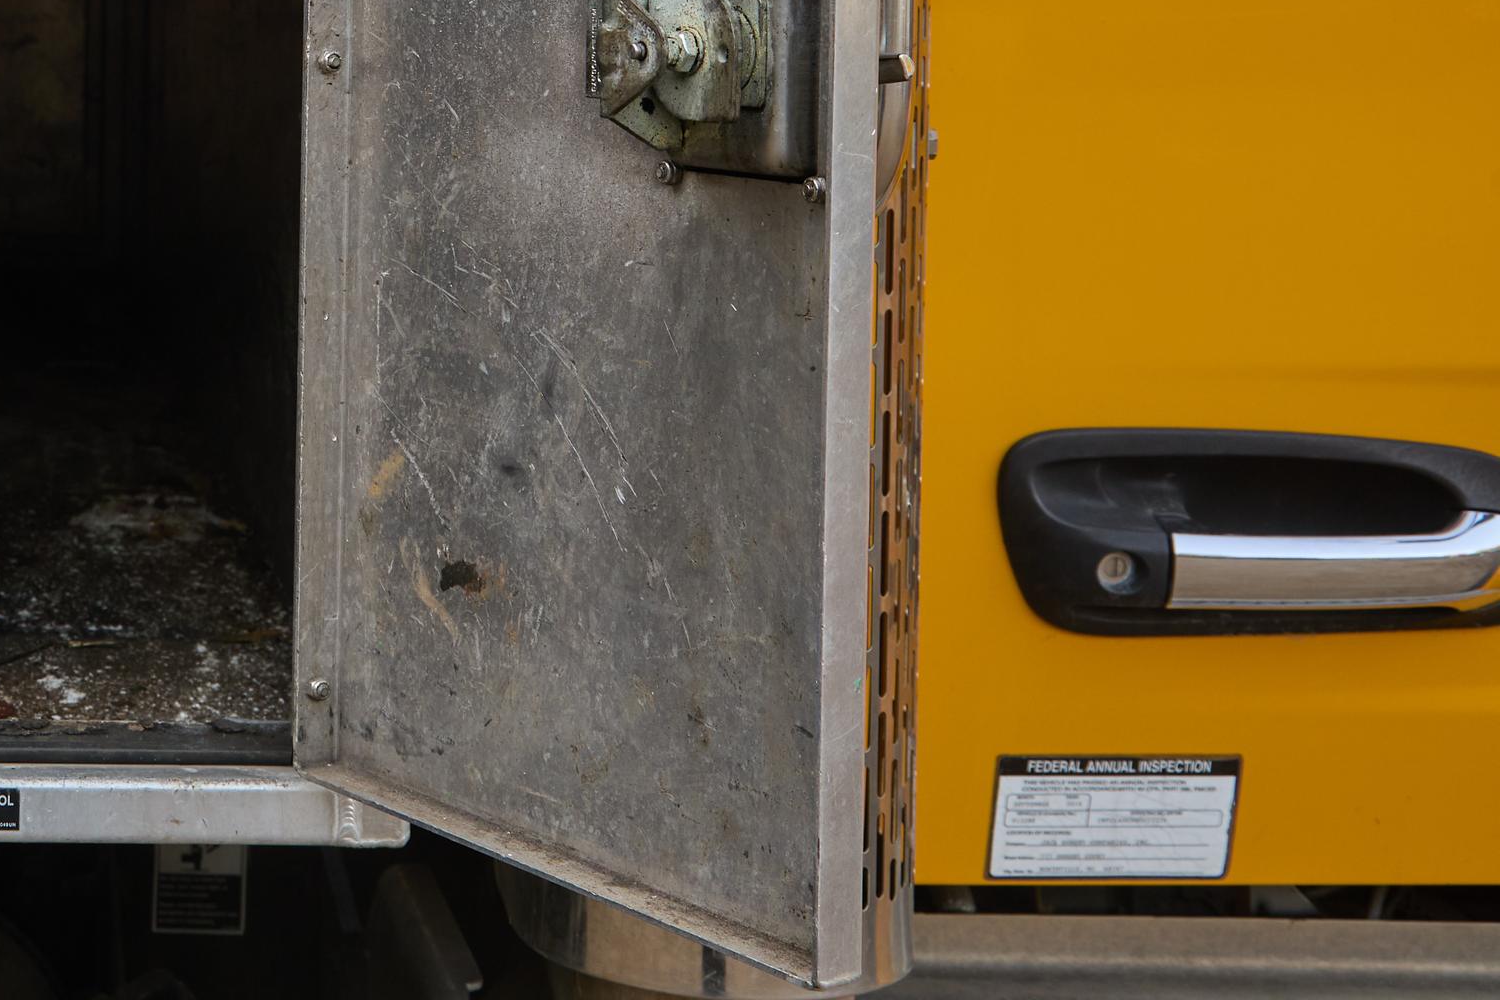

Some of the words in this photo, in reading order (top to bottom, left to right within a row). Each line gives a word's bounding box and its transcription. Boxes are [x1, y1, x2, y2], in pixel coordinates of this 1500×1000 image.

[1027, 760, 1083, 774] FEDERAL
[1086, 760, 1136, 774] ANNUAL
[1139, 760, 1212, 774] INSPECTION
